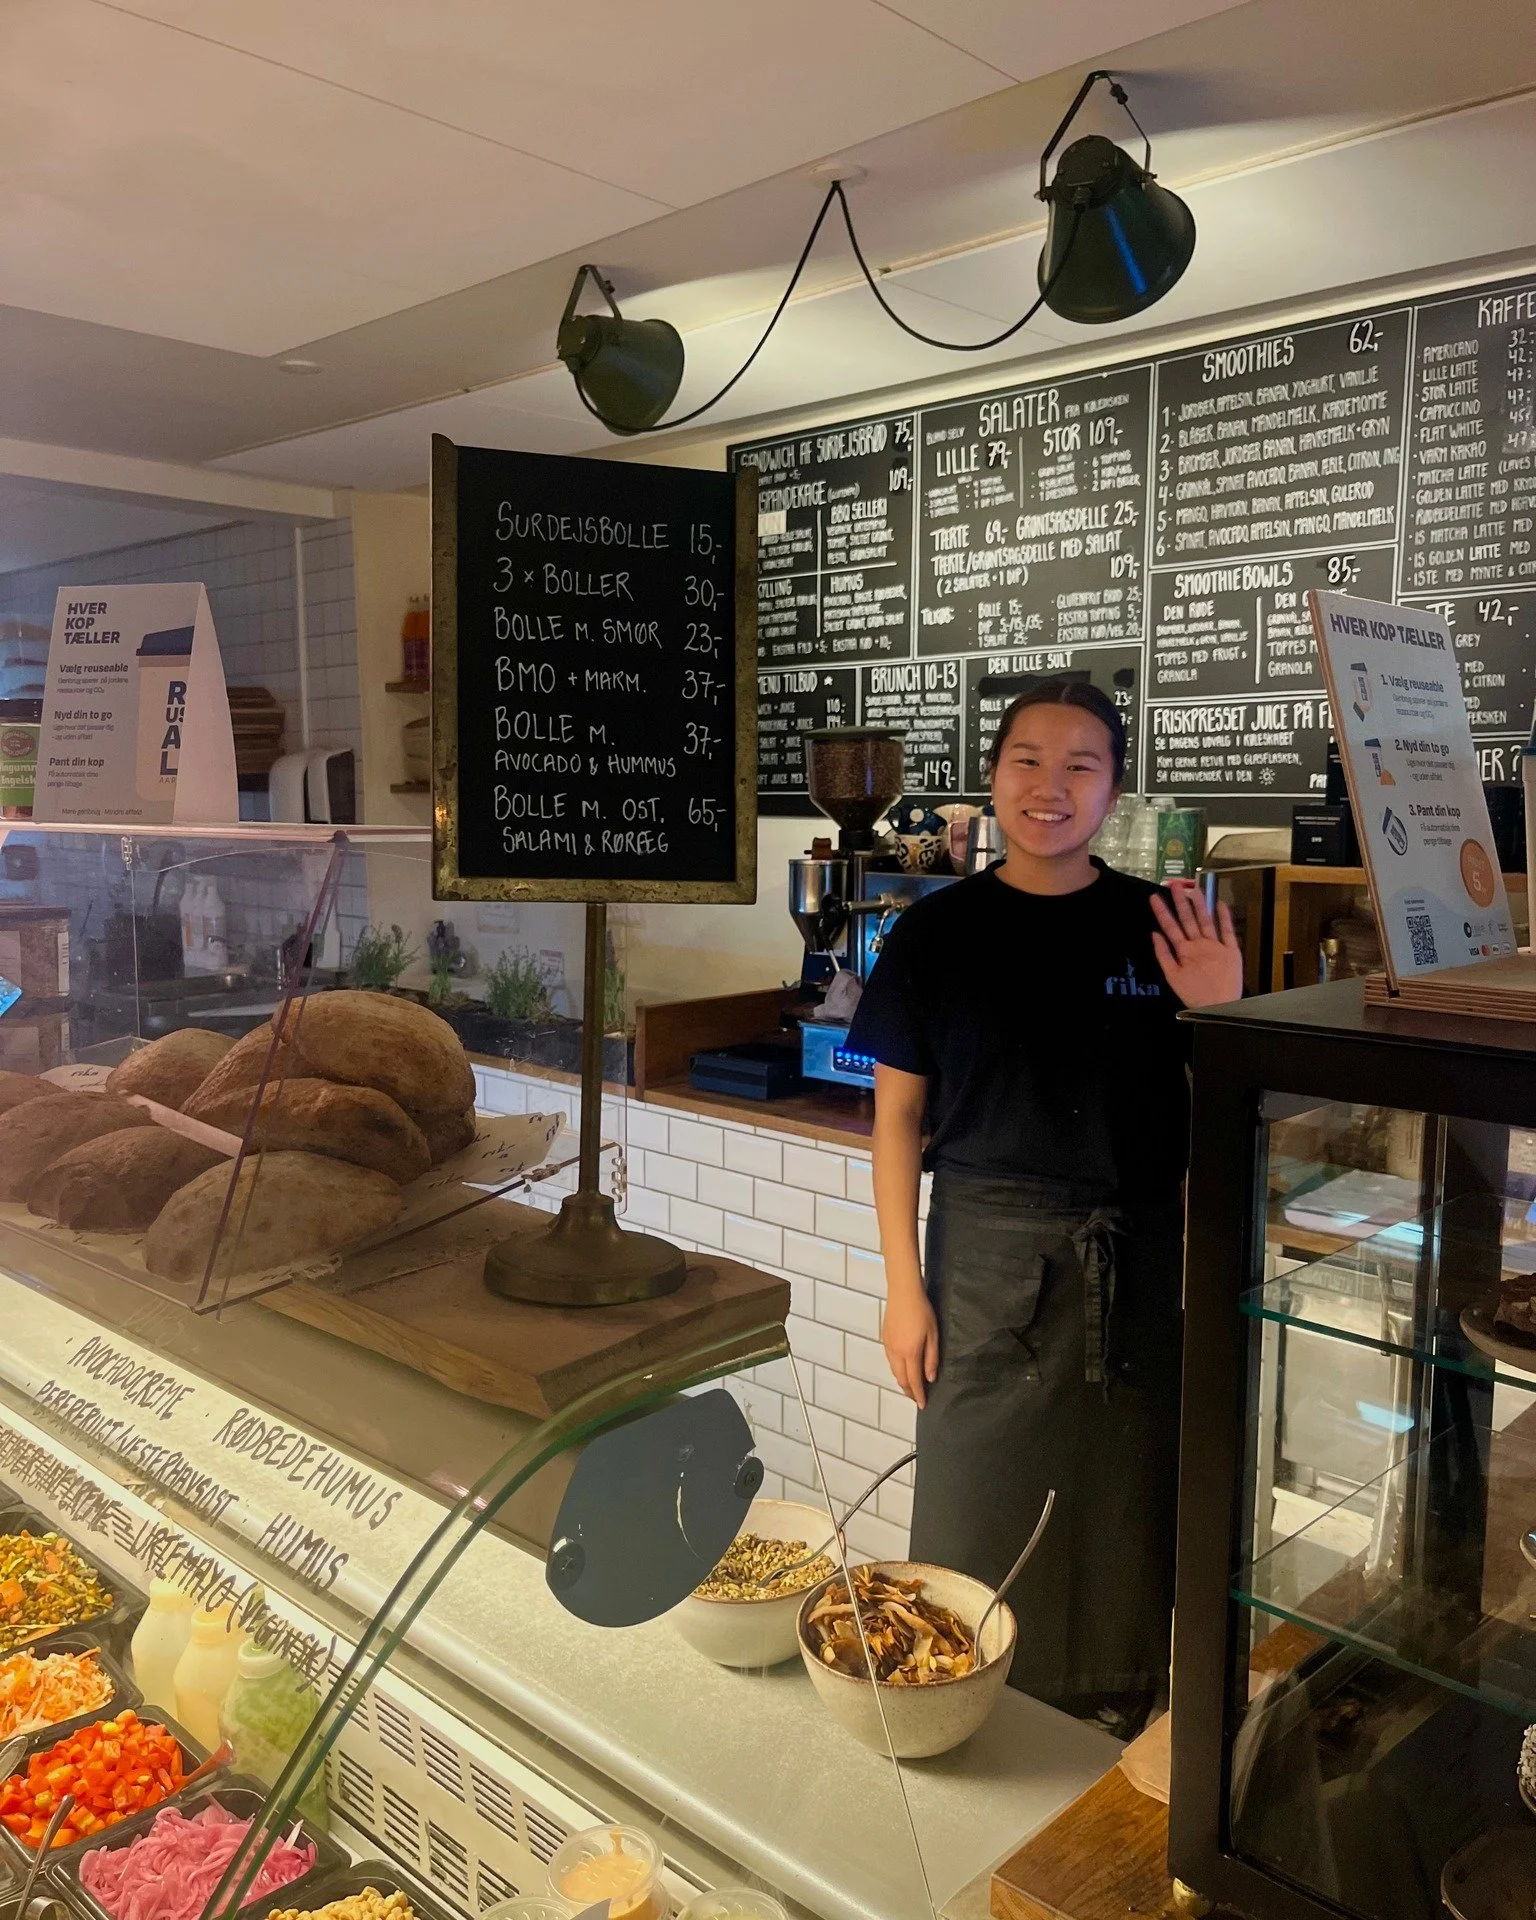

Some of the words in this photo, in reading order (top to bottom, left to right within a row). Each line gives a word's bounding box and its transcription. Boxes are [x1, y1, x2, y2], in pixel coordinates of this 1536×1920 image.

[1477, 291, 1536, 328] KAFFE
[1201, 336, 1295, 383] SMOOTHIES
[1349, 319, 1384, 354] 62,-
[1423, 339, 1480, 364] AMERICANO
[1339, 365, 1379, 389] VANILJE
[1422, 365, 1448, 383] LILLE
[1451, 359, 1478, 379] LATTE
[1421, 383, 1447, 403] STOR
[1450, 378, 1479, 397] LATTE
[978, 387, 1061, 438] SALATER
[1322, 390, 1388, 420] KARDEMOMME
[1419, 399, 1481, 423] CAPPUCCINO
[1420, 424, 1447, 443] FLAT
[1450, 418, 1485, 439] WHITE
[936, 443, 980, 478] LILLE
[987, 440, 1013, 470] 79,-
[1043, 423, 1081, 457] STOR
[1089, 416, 1124, 446] 109,-
[1419, 447, 1447, 465] VARM
[1450, 440, 1487, 462] KAKAO
[888, 466, 914, 492] 109,-
[1417, 468, 1454, 486] MATCHA
[1458, 462, 1489, 481] LATTE
[1331, 480, 1375, 504] GULEROD
[1416, 487, 1452, 505] GOLDEN
[1455, 482, 1485, 500] LATTE
[1490, 479, 1509, 495] MED
[851, 497, 888, 521] SELLERI
[1490, 500, 1507, 515] MED
[495, 501, 669, 549] SURDEJSBOLLE
[689, 523, 722, 565] 15,-
[930, 524, 970, 551] TÆRTE
[985, 519, 1009, 544] 69,-
[1016, 504, 1109, 540] GRØNTSAGSDELLE
[1113, 500, 1139, 527] 25,-
[1414, 530, 1425, 546] IS
[1430, 527, 1468, 543] MATCHA
[1473, 521, 1506, 539] LATTE
[1513, 518, 1533, 533] MED
[1060, 537, 1082, 559] MED
[1085, 530, 1123, 556] SALAT
[1414, 551, 1425, 568] IS
[1429, 548, 1464, 566] GOLDEN
[1469, 543, 1501, 561] LATTE
[1510, 541, 1531, 555] MED
[1110, 553, 1140, 579] 109,-
[1174, 562, 1294, 599] SMOOTHIEBOWLS
[1328, 555, 1362, 584] 85,-
[1445, 569, 1464, 583] MED
[1470, 564, 1503, 580] MYNTE
[493, 557, 514, 592] 3
[543, 563, 634, 602] BOLLER
[684, 575, 724, 611] 30,-
[830, 572, 864, 594] HUMUS
[953, 573, 991, 592] SALATER
[67, 602, 107, 615] HVER
[977, 601, 1001, 619] BOLLE
[1164, 604, 1184, 621] DEN
[1189, 600, 1215, 618] RØDE
[1275, 591, 1297, 610] DEN
[1479, 599, 1519, 626] 42,-
[65, 617, 95, 629] KOP
[1058, 610, 1088, 627] EKSTRA
[1089, 605, 1120, 623] TOPPING
[64, 631, 120, 645] TÆLLER
[493, 606, 564, 641] BOLLE
[575, 622, 595, 642] M.
[603, 618, 662, 649] SMØR
[684, 622, 723, 659] 23,-
[1057, 626, 1088, 643] EKSTRA
[1330, 613, 1369, 638] HVER
[1369, 620, 1396, 641] KOP
[1397, 626, 1446, 650] TÆLLER
[1455, 633, 1481, 648] GREY
[1154, 651, 1187, 667] TOPPES
[1191, 649, 1208, 664] MED
[1212, 646, 1240, 662] FRUGT
[1266, 639, 1307, 657] TOPPES
[60, 664, 82, 674] Vælg
[83, 663, 129, 673] reuseable
[987, 656, 1009, 675] DEN
[1012, 654, 1043, 673] LILLE
[1046, 651, 1073, 669] SULT
[1267, 661, 1313, 678] GRANOLA
[1465, 662, 1484, 673] MED
[495, 656, 556, 693] BMO
[568, 672, 577, 685] +
[585, 669, 647, 693] MARM.
[681, 670, 726, 706] 37,-
[782, 672, 818, 693] TILBUD
[871, 664, 921, 693] BRUNCH
[924, 662, 958, 690] 10-13
[1156, 669, 1198, 684] GRANOLA
[1388, 675, 1409, 691] Vælg
[1409, 679, 1444, 692] reuseable
[1472, 674, 1506, 688] CITRON
[54, 710, 72, 721] Nyd
[74, 710, 88, 719] din
[90, 711, 99, 719] to
[101, 711, 112, 721] go
[979, 697, 1002, 713] BOLLE
[1153, 705, 1248, 735] FRISKPRESSET
[1250, 704, 1289, 732] JUICE
[1292, 700, 1313, 730] PÅ
[495, 705, 574, 743] BOLLE
[589, 725, 615, 746] M.
[683, 722, 722, 760] 37,-
[1169, 735, 1200, 750] DAGENS
[1202, 734, 1231, 748] UDVALG
[1243, 731, 1295, 747] KØLESKABET
[1403, 740, 1417, 753] Nyd
[1419, 742, 1430, 753] din
[1431, 743, 1439, 753] to
[1440, 745, 1449, 756] go
[50, 757, 70, 766] Pant
[72, 757, 86, 766] din
[88, 757, 104, 768] kop
[495, 749, 581, 773] AVOCADO
[589, 756, 598, 775] &
[607, 754, 676, 778] HUMMUS
[1175, 756, 1198, 768] GERNE
[1200, 754, 1225, 767] RETUR
[1227, 754, 1242, 766] MED
[1236, 770, 1253, 782] DEN
[493, 784, 567, 820] BOLLE
[581, 800, 607, 820] M.
[622, 797, 665, 824] OST.
[688, 797, 727, 832] 65,-
[1417, 805, 1433, 816] Pant
[1435, 806, 1446, 816] din
[502, 826, 577, 856] SALAMI
[584, 833, 595, 856] &
[601, 829, 669, 856] RØRÆG
[67, 1336, 195, 1421] AVOCADOCREME
[213, 1407, 403, 1530] RØDBEDEHUMUS
[255, 1513, 350, 1592] HUMUS
[129, 1520, 237, 1613] URTEMAYO
